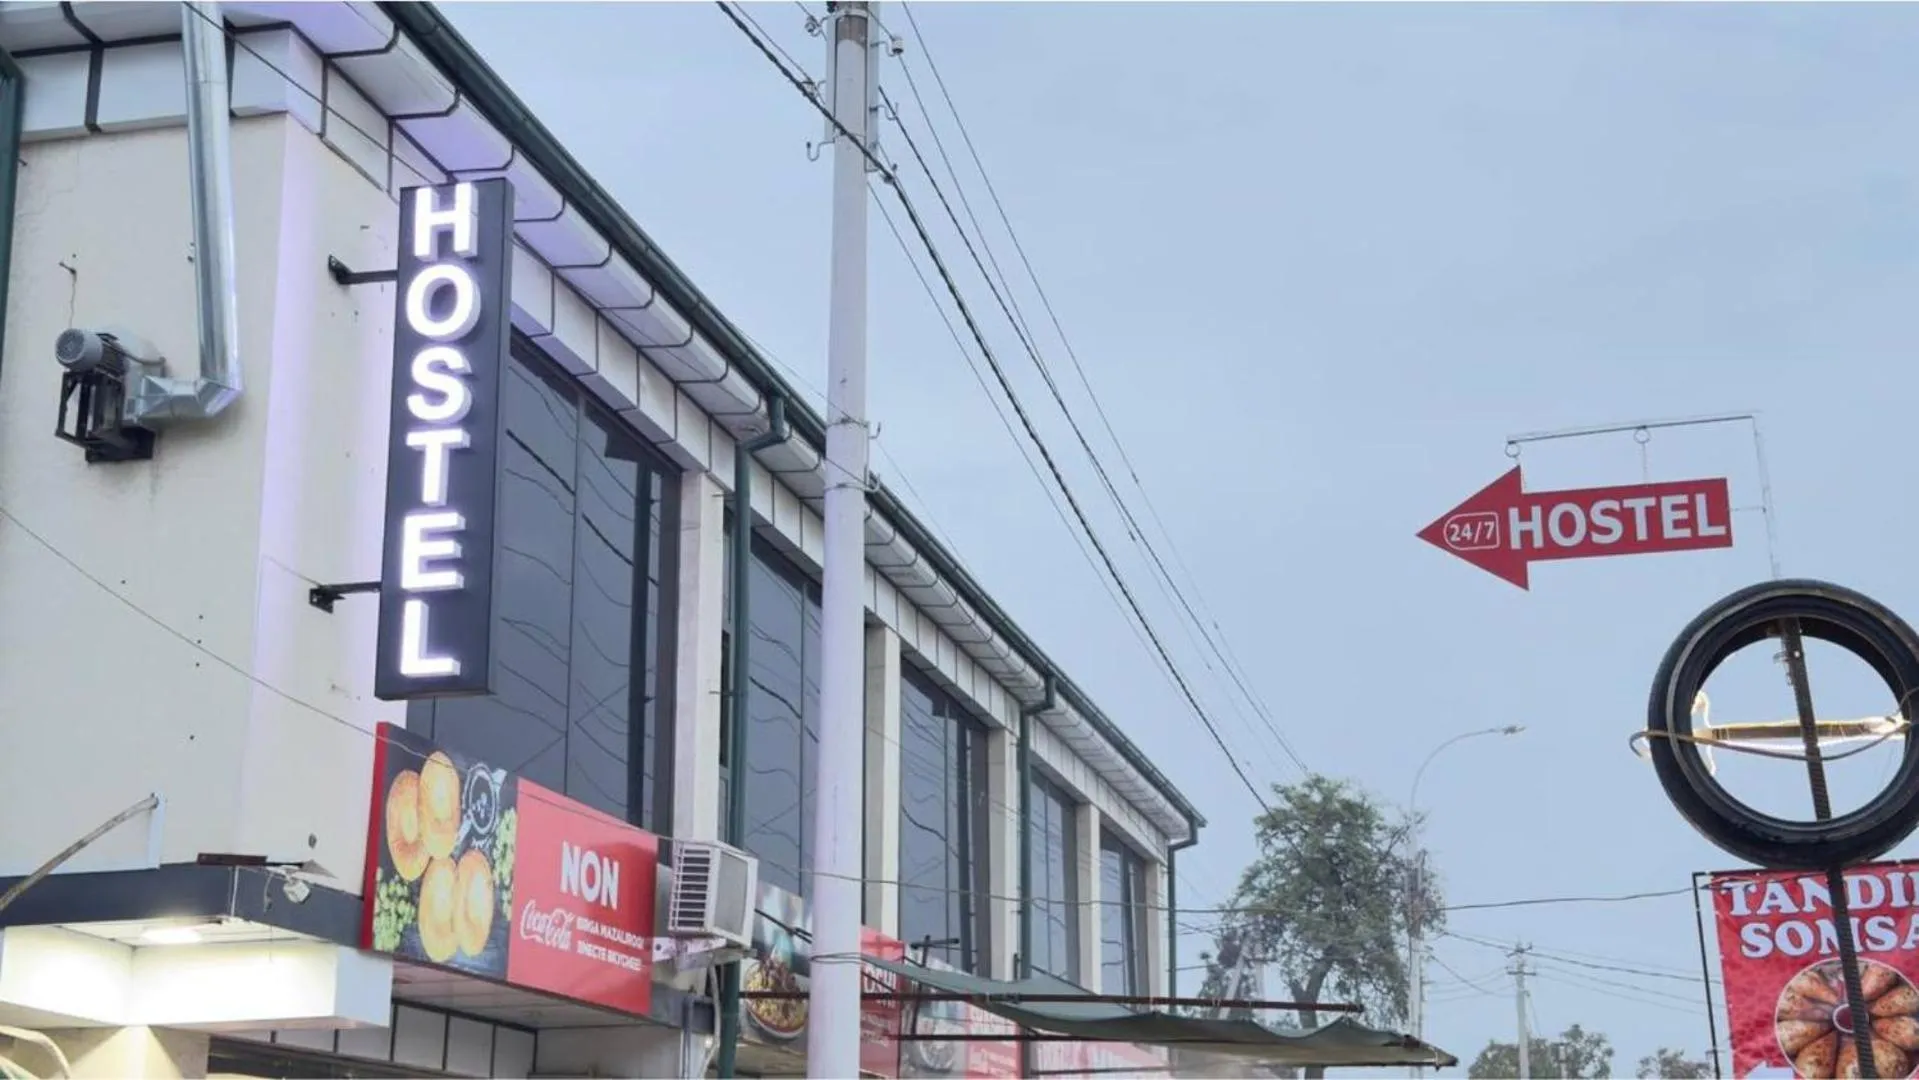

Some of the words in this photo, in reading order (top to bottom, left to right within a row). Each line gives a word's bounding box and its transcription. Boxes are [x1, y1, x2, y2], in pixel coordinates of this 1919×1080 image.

[400, 181, 481, 679] HOSTEL
[1449, 520, 1495, 543] 24/7
[1508, 493, 1726, 550] HOSTEL
[560, 840, 619, 910] NON
[1720, 871, 1919, 917] TANDI
